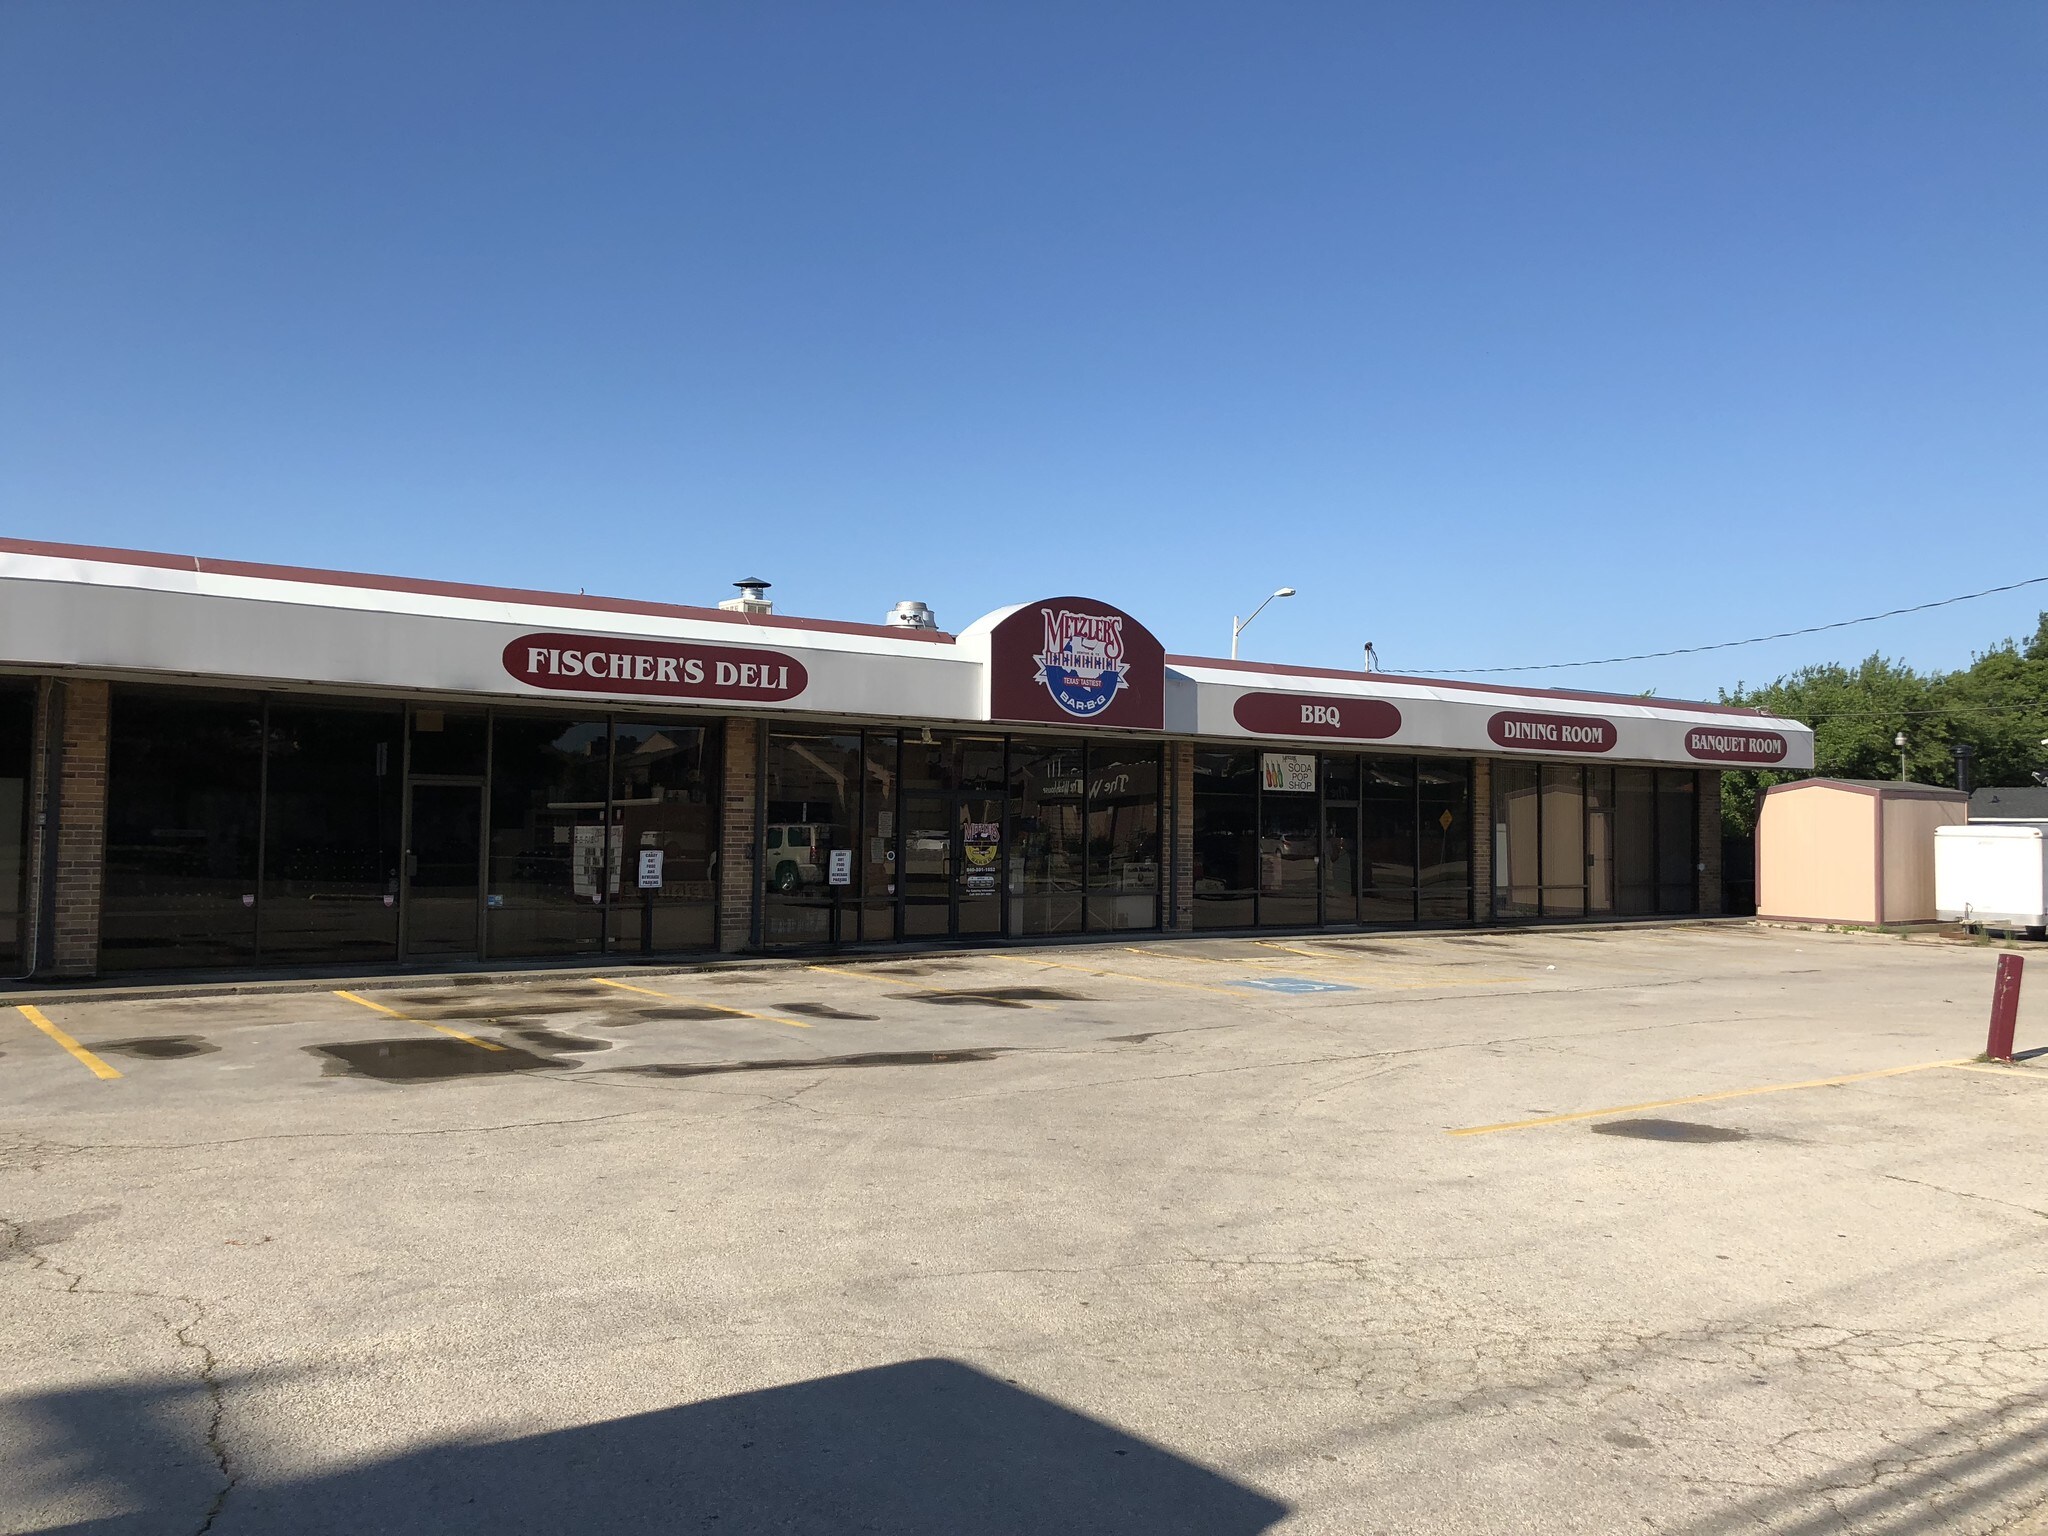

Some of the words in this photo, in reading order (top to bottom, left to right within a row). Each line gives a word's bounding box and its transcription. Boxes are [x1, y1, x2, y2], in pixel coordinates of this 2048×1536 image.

[526, 647, 705, 684] FISCHER'S
[714, 660, 789, 690] DELI
[1080, 679, 1102, 687] TASTIEST
[1300, 704, 1341, 728] BBQ
[1503, 720, 1558, 741] DINING
[1561, 725, 1603, 744] ROOM
[1691, 734, 1746, 754] BANQUET
[1748, 738, 1782, 754] ROOM
[1288, 763, 1312, 773] SODA
[1291, 772, 1309, 782] POP
[1288, 781, 1312, 790] SHOP
